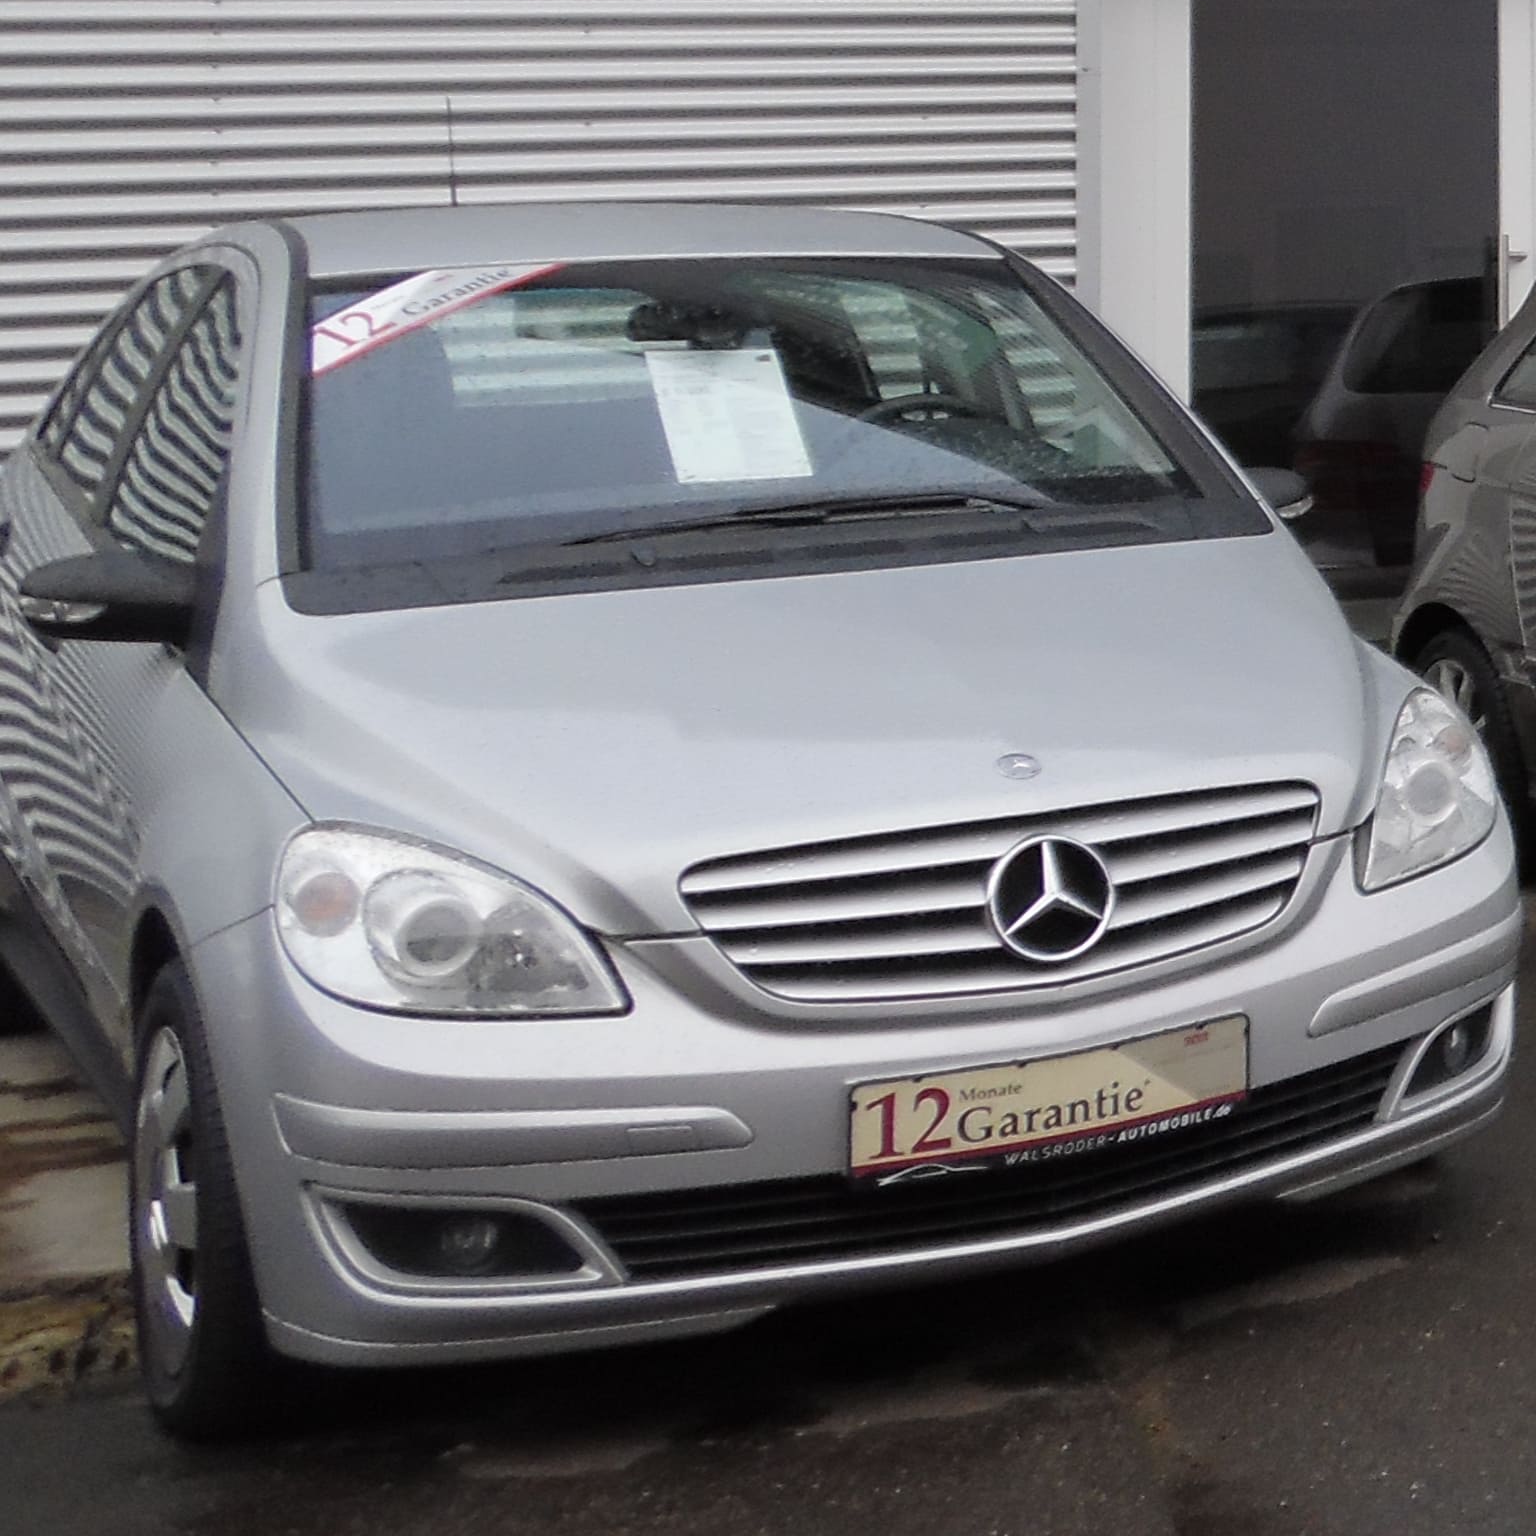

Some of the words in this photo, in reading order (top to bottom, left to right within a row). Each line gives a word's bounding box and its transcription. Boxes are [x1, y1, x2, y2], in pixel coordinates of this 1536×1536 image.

[401, 268, 512, 316] Garantie
[314, 311, 397, 347] 12
[958, 1081, 1024, 1104] Monate
[865, 1086, 953, 1160] 12
[955, 1084, 1145, 1145] Garantie
[1004, 1103, 1232, 1165] WALSRODER-AUTOMOBILE.de
